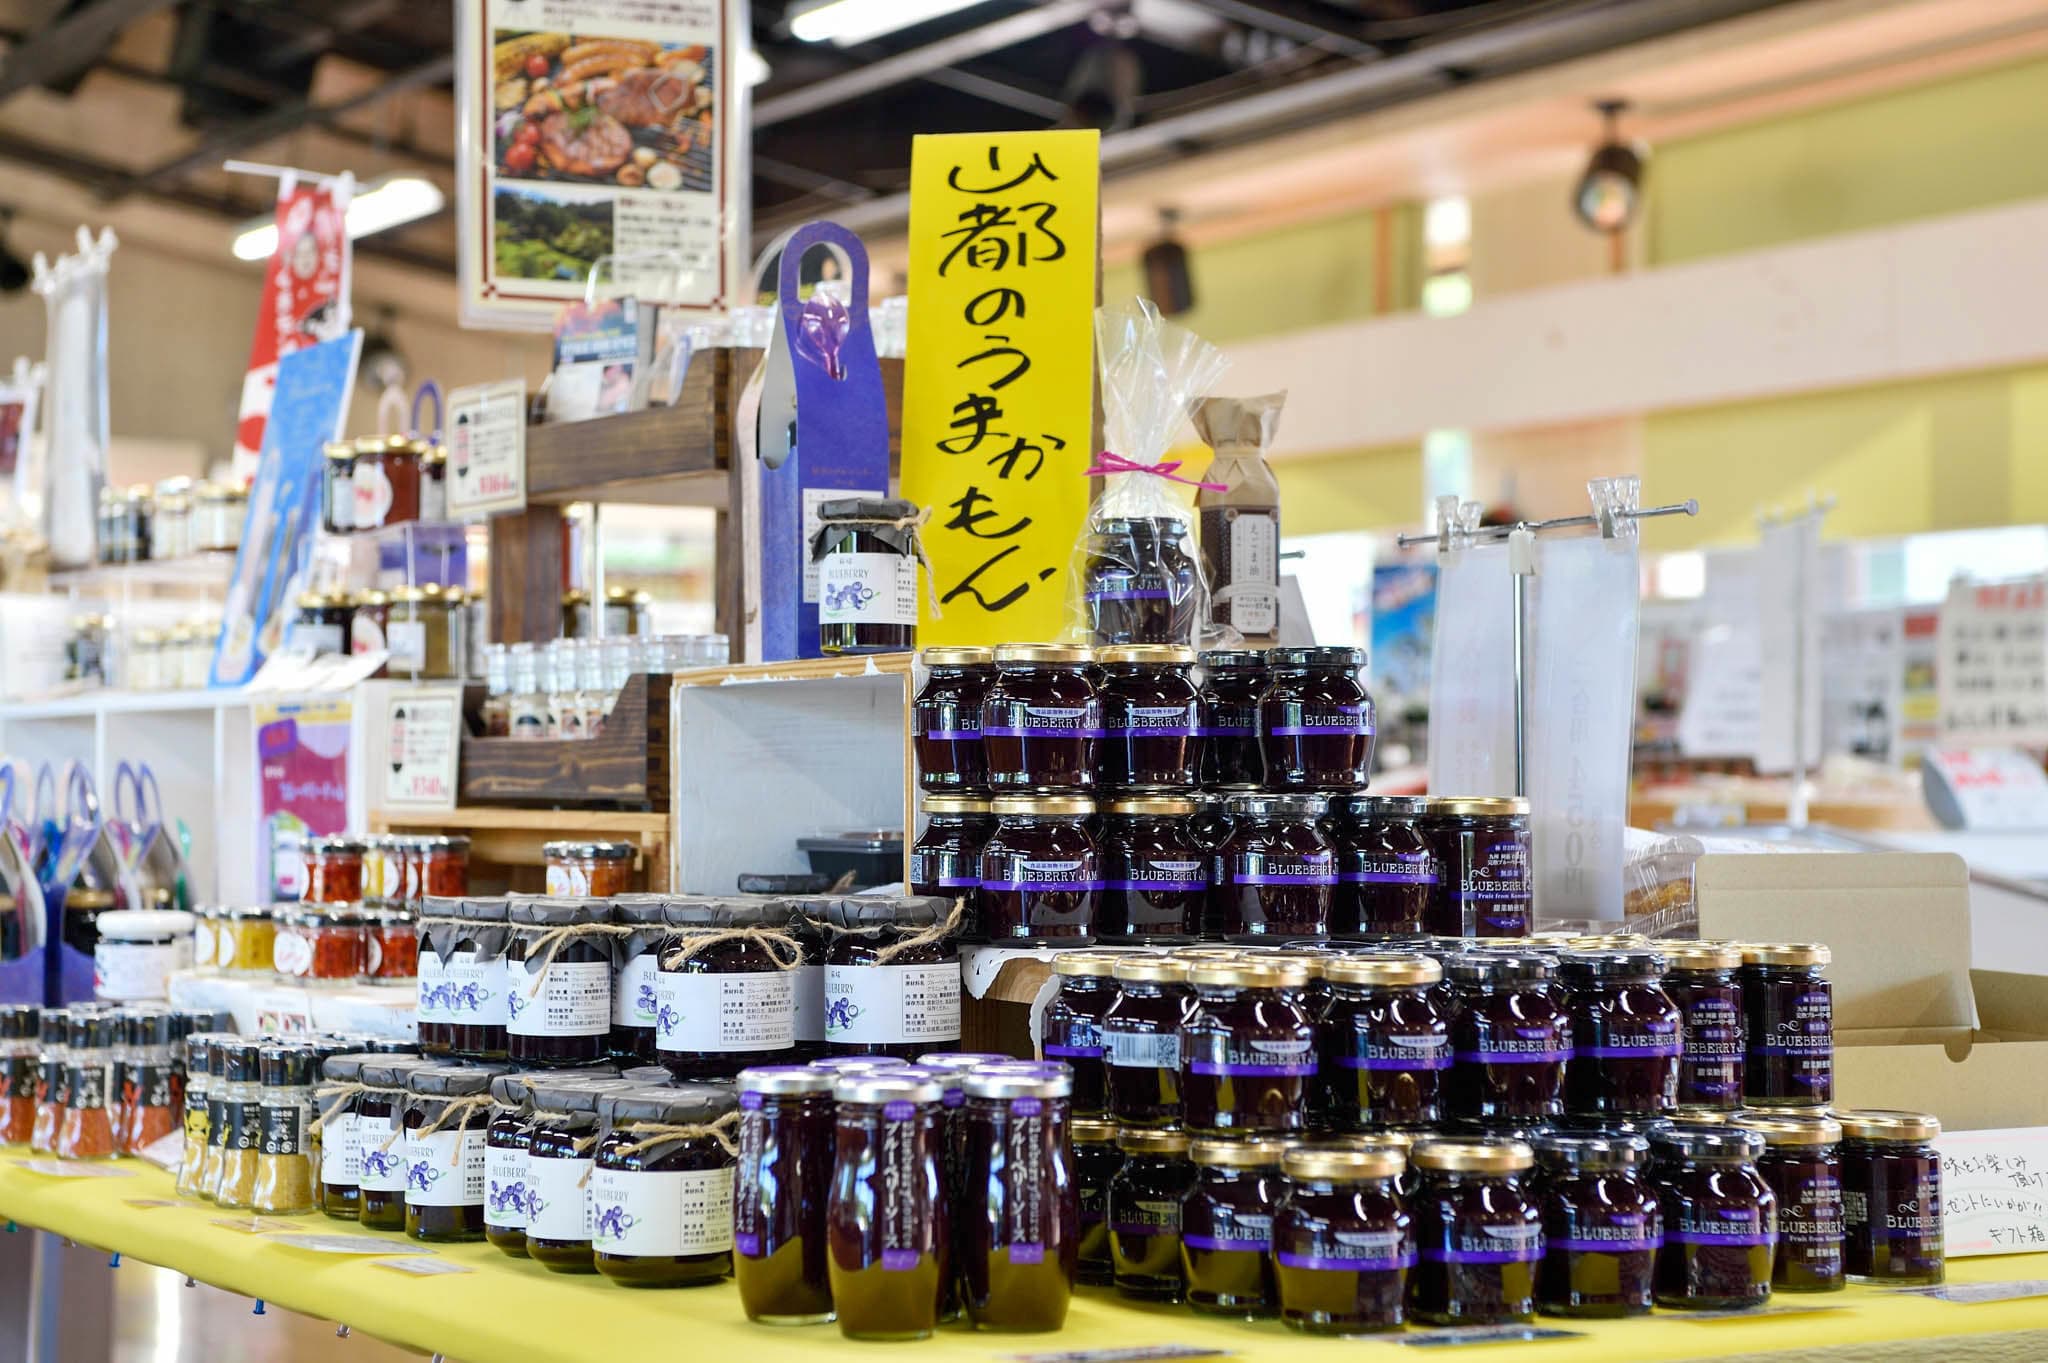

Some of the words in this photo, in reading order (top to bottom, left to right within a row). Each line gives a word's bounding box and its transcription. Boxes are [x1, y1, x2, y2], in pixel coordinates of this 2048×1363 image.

[1079, 869, 1098, 881] JAM
[1130, 868, 1197, 881] BLUEBERRY
[1478, 1039, 1558, 1053] BLUEBERRY
[883, 1120, 900, 1249] ブルーベリーソース
[1011, 1116, 1028, 1243] ブルーベリーソース
[1989, 1223, 2046, 1244] ギフト箱
